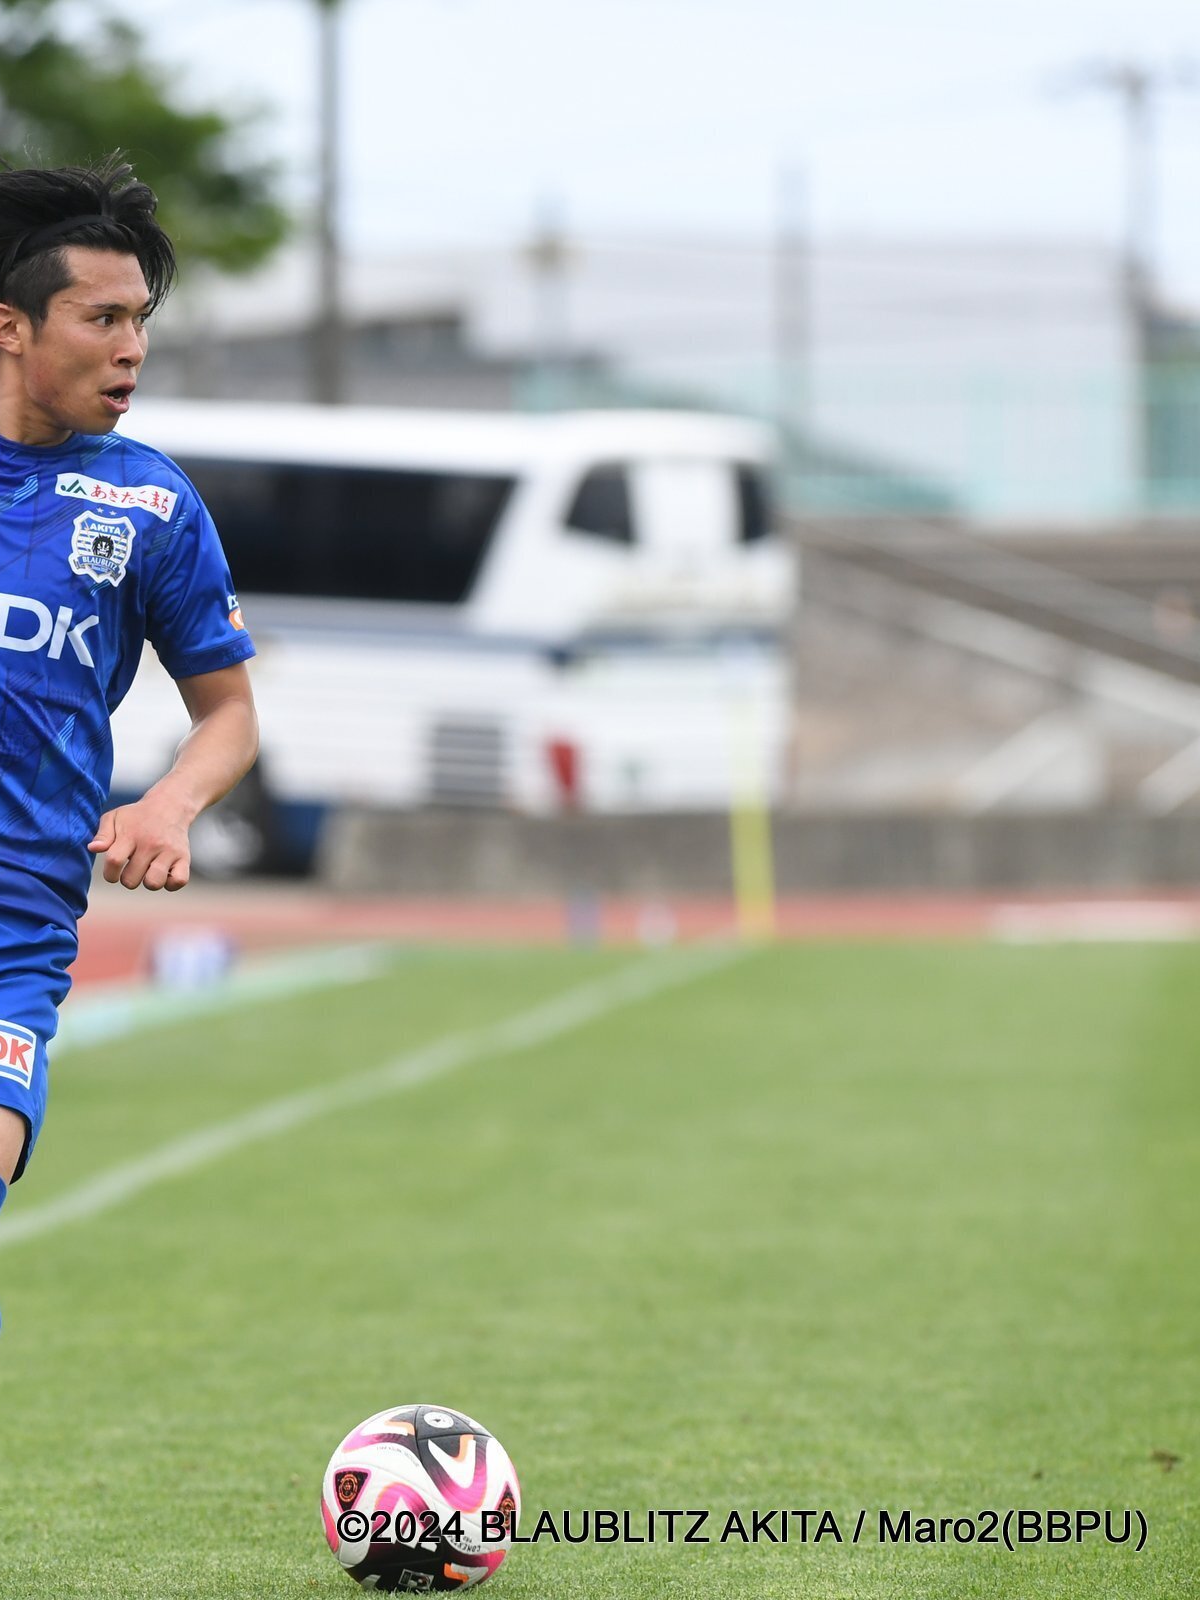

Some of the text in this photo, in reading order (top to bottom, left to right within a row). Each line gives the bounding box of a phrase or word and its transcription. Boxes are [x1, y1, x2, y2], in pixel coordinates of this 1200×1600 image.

[90, 484, 169, 514] あきたこまち
[89, 523, 121, 535] AKITA
[82, 556, 118, 571] BLAUBLITZ
